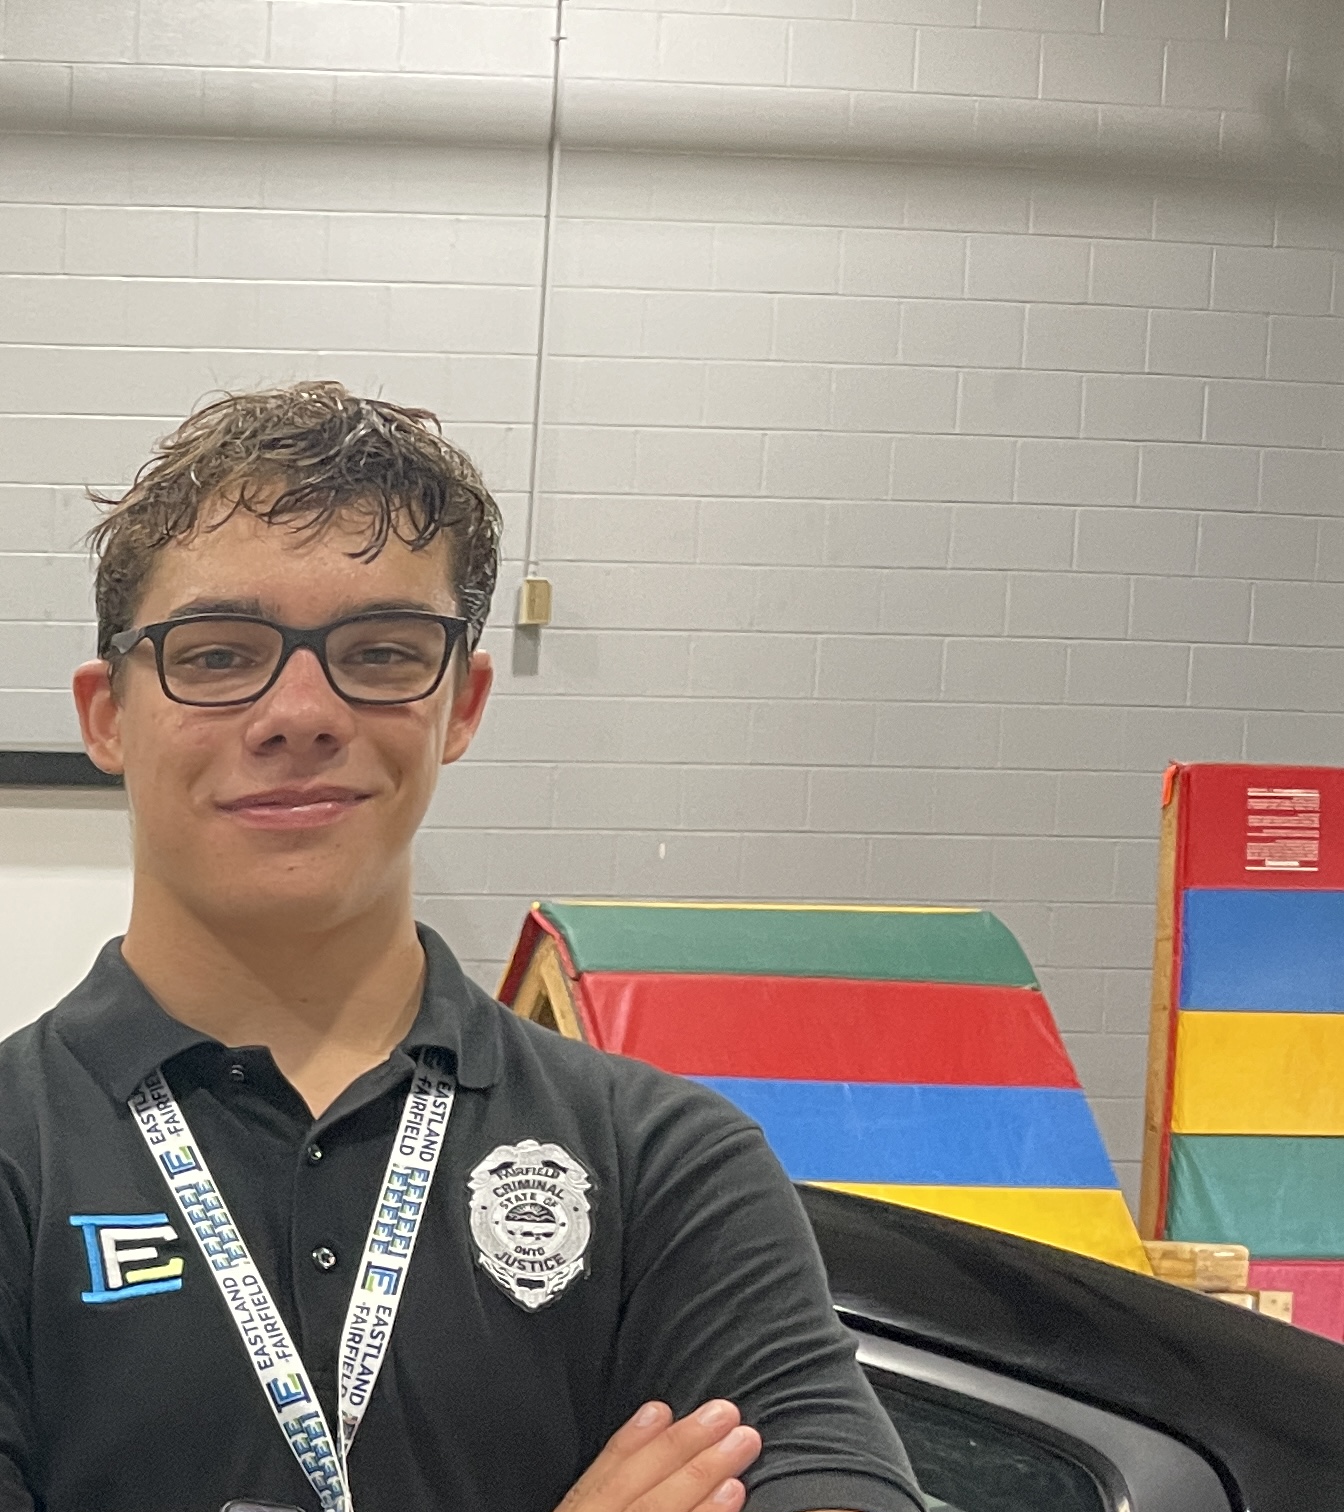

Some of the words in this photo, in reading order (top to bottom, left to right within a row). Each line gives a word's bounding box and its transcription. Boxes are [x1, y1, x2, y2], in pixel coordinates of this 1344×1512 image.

[419, 1080, 451, 1162] EASTLAND
[493, 1179, 564, 1200] CRIMINAL
[499, 1192, 537, 1210] STATE
[543, 1198, 559, 1208] OF
[495, 1253, 567, 1272] JUSTICE
[223, 1276, 274, 1371] EASTLAND
[349, 1304, 393, 1406] EASTLAND
